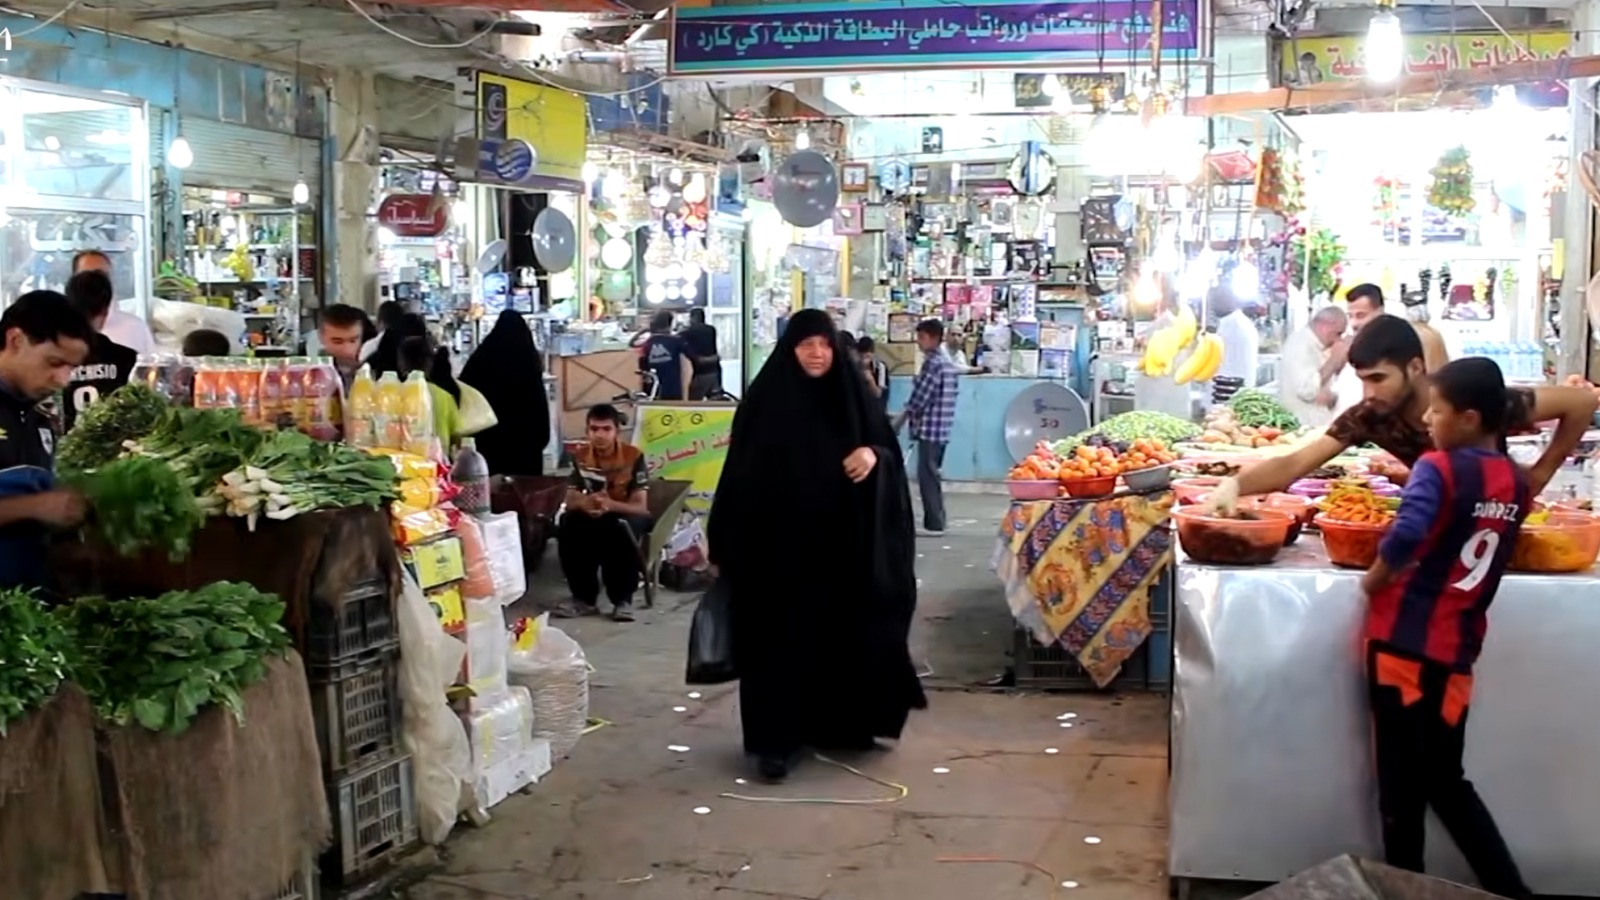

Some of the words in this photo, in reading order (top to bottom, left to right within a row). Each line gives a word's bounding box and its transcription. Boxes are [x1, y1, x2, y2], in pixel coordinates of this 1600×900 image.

[697, 25, 733, 51] كارد
[773, 21, 830, 49] الذكية
[833, 18, 905, 46] البطاقة
[908, 17, 962, 50] حاملي
[1451, 528, 1499, 591] 9
